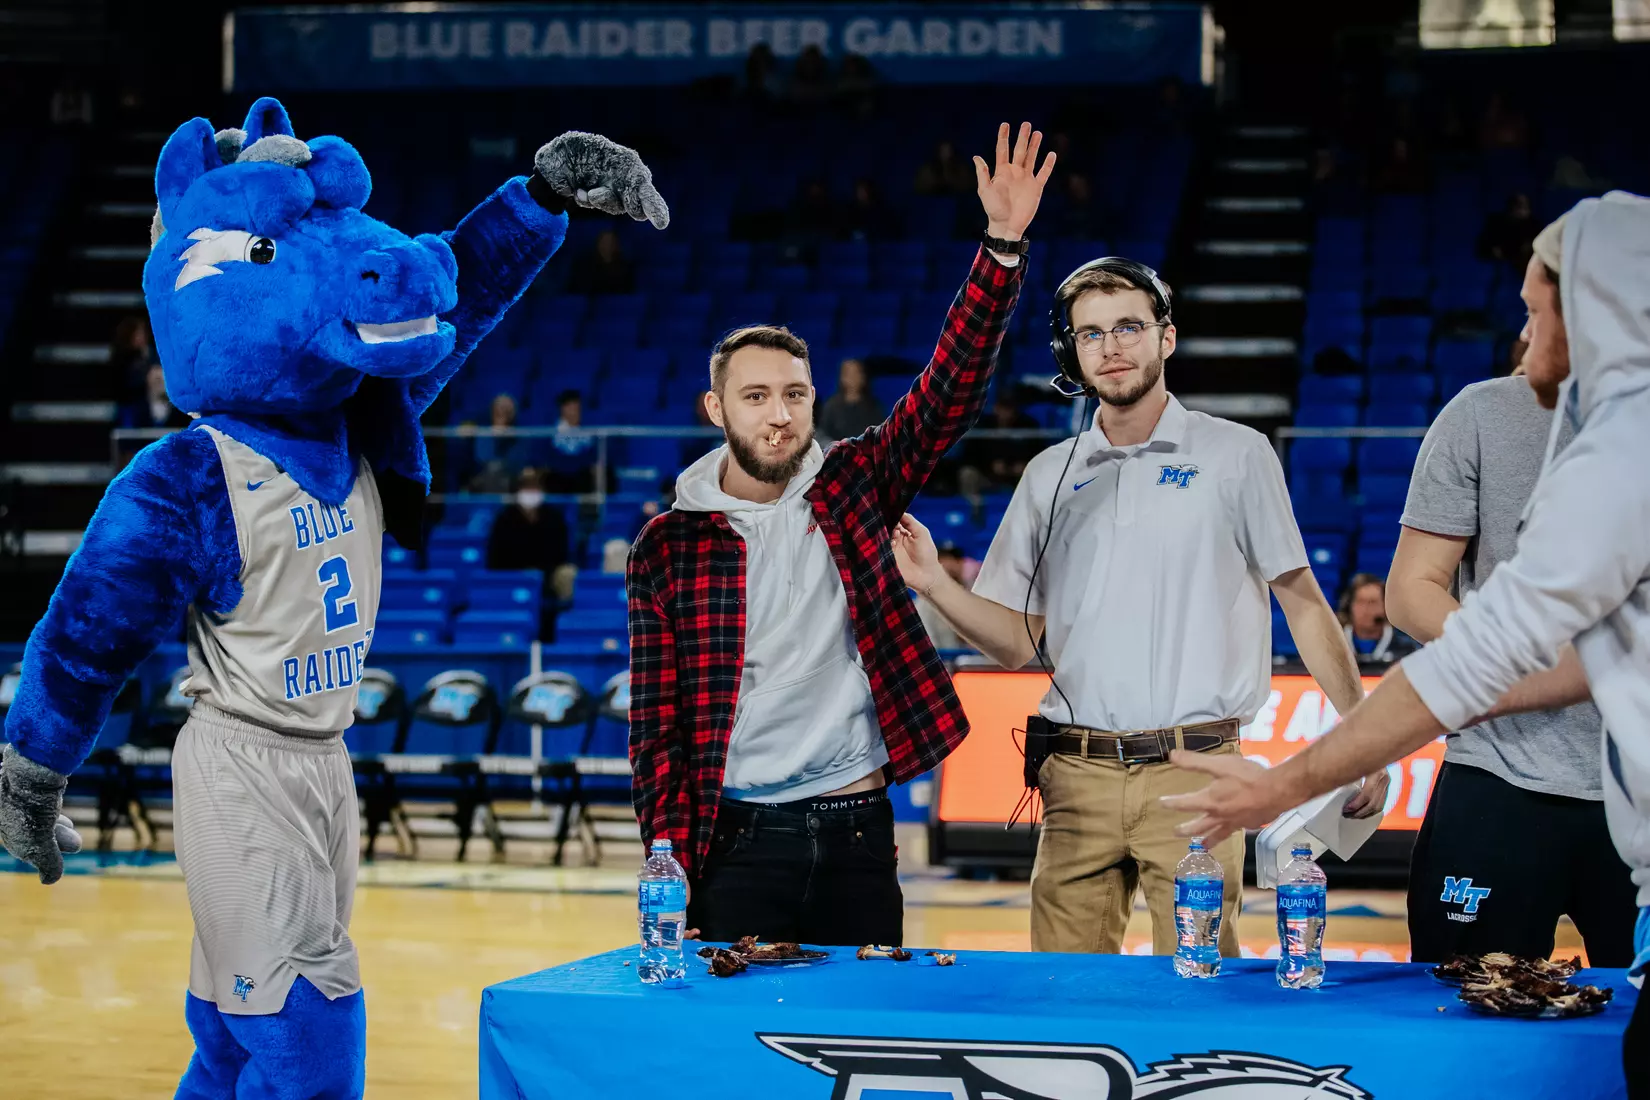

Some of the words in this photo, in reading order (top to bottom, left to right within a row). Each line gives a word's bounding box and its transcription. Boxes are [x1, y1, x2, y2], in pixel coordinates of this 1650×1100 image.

[370, 20, 494, 59] BLUE
[504, 19, 695, 58] RAIDER
[707, 19, 831, 57] BEER
[843, 18, 1064, 56] GARDEN
[1157, 465, 1197, 489] MT
[289, 501, 355, 550] BLUE
[316, 553, 360, 636] 2
[282, 632, 372, 701] RAIDE
[811, 799, 856, 811] TOMMY
[1279, 896, 1318, 910] AQUAFINA
[1440, 876, 1491, 913] MT
